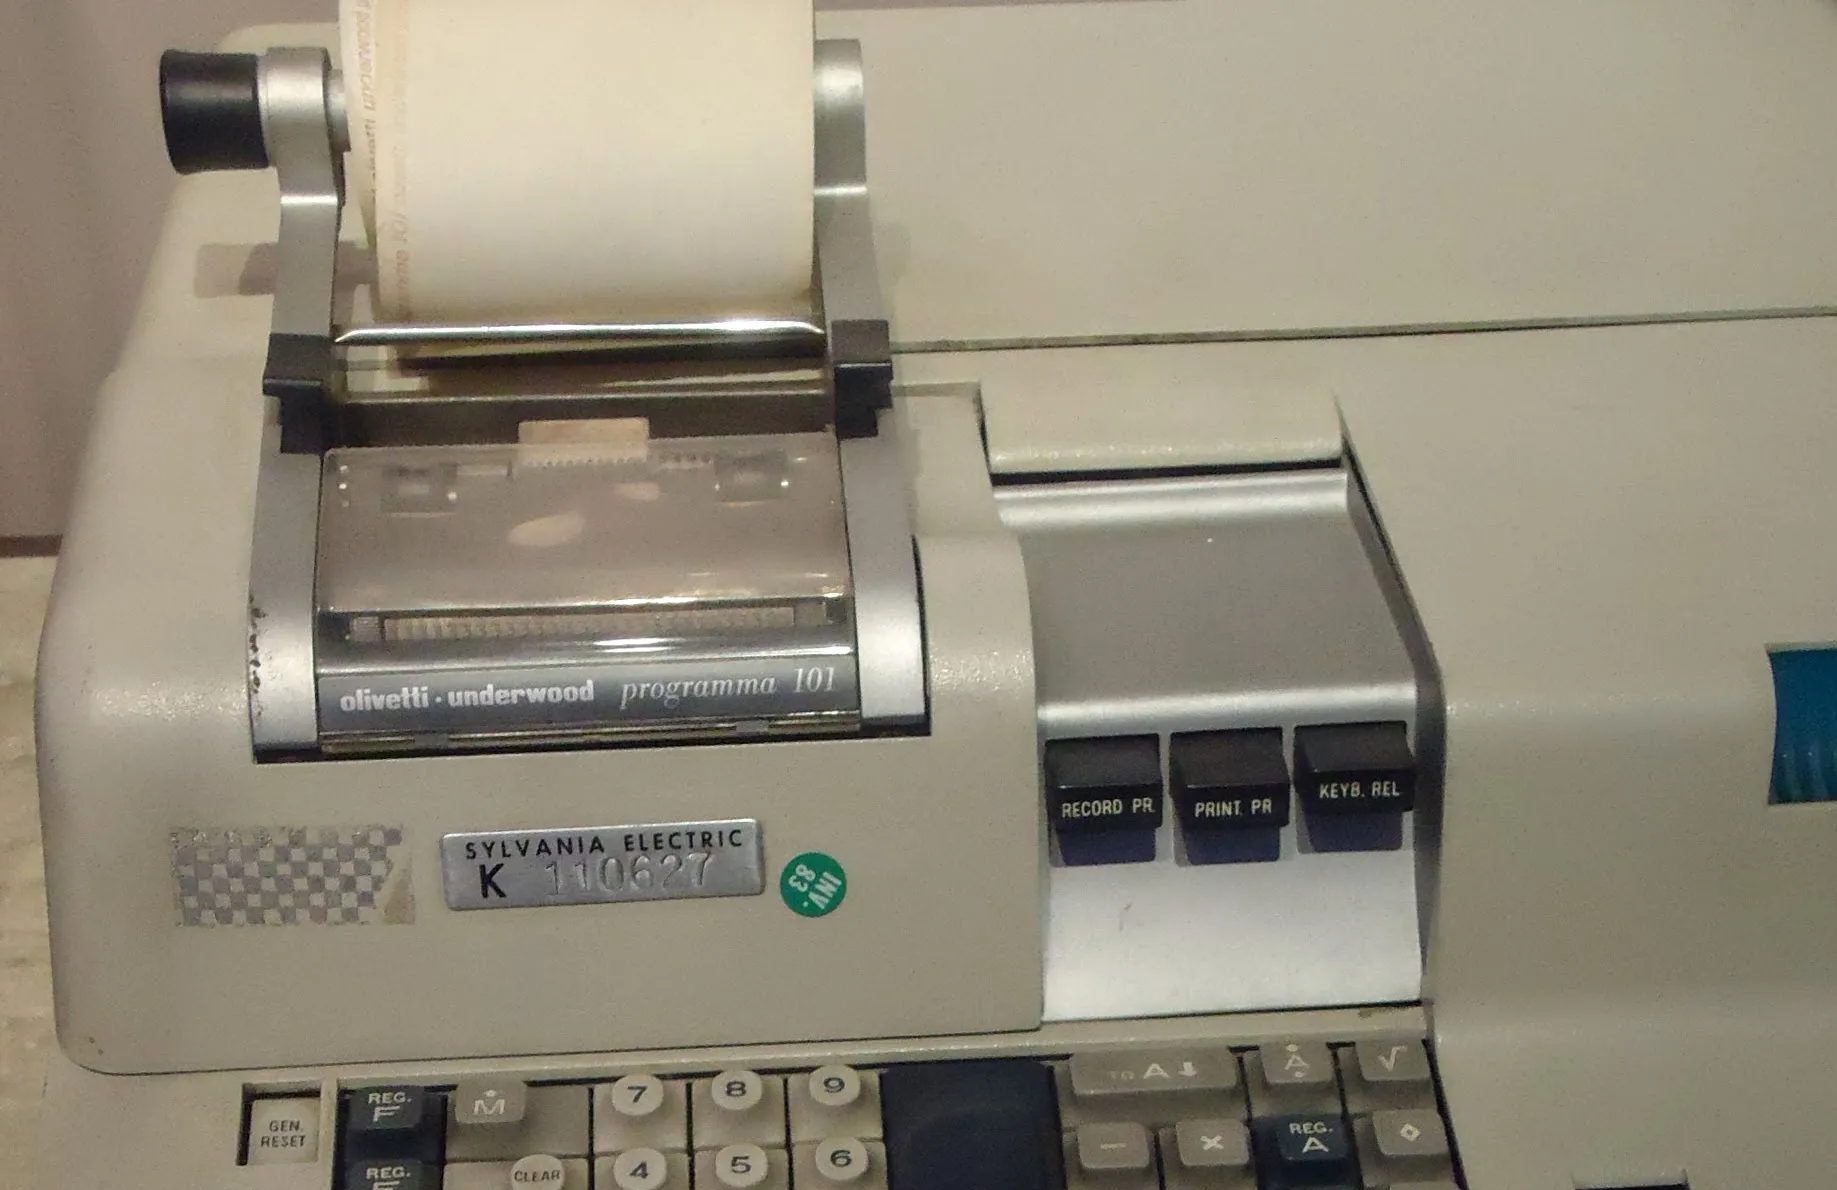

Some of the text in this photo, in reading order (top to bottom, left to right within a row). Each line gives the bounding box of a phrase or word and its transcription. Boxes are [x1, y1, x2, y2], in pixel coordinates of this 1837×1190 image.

[340, 667, 836, 712] olivetti underwood programma 101
[1319, 781, 1365, 799] KEYB.
[1061, 798, 1123, 818] RECORD
[465, 829, 743, 860] SYLVANIA ELECTRIC
[479, 852, 712, 899] K 110627
[1143, 1063, 1170, 1080] A
[626, 1085, 647, 1103] 7
[724, 1081, 748, 1098] 8
[822, 1076, 846, 1094] 9
[368, 1091, 412, 1106] REG.
[372, 1104, 401, 1122] F
[1288, 1122, 1334, 1135] REG.
[260, 1135, 306, 1148] RESET
[1302, 1137, 1330, 1153] A
[730, 1155, 752, 1175] 5
[829, 1149, 853, 1167] 6
[366, 1166, 412, 1180] REG.
[513, 1170, 561, 1182] CLEAR
[629, 1162, 652, 1180] 4
